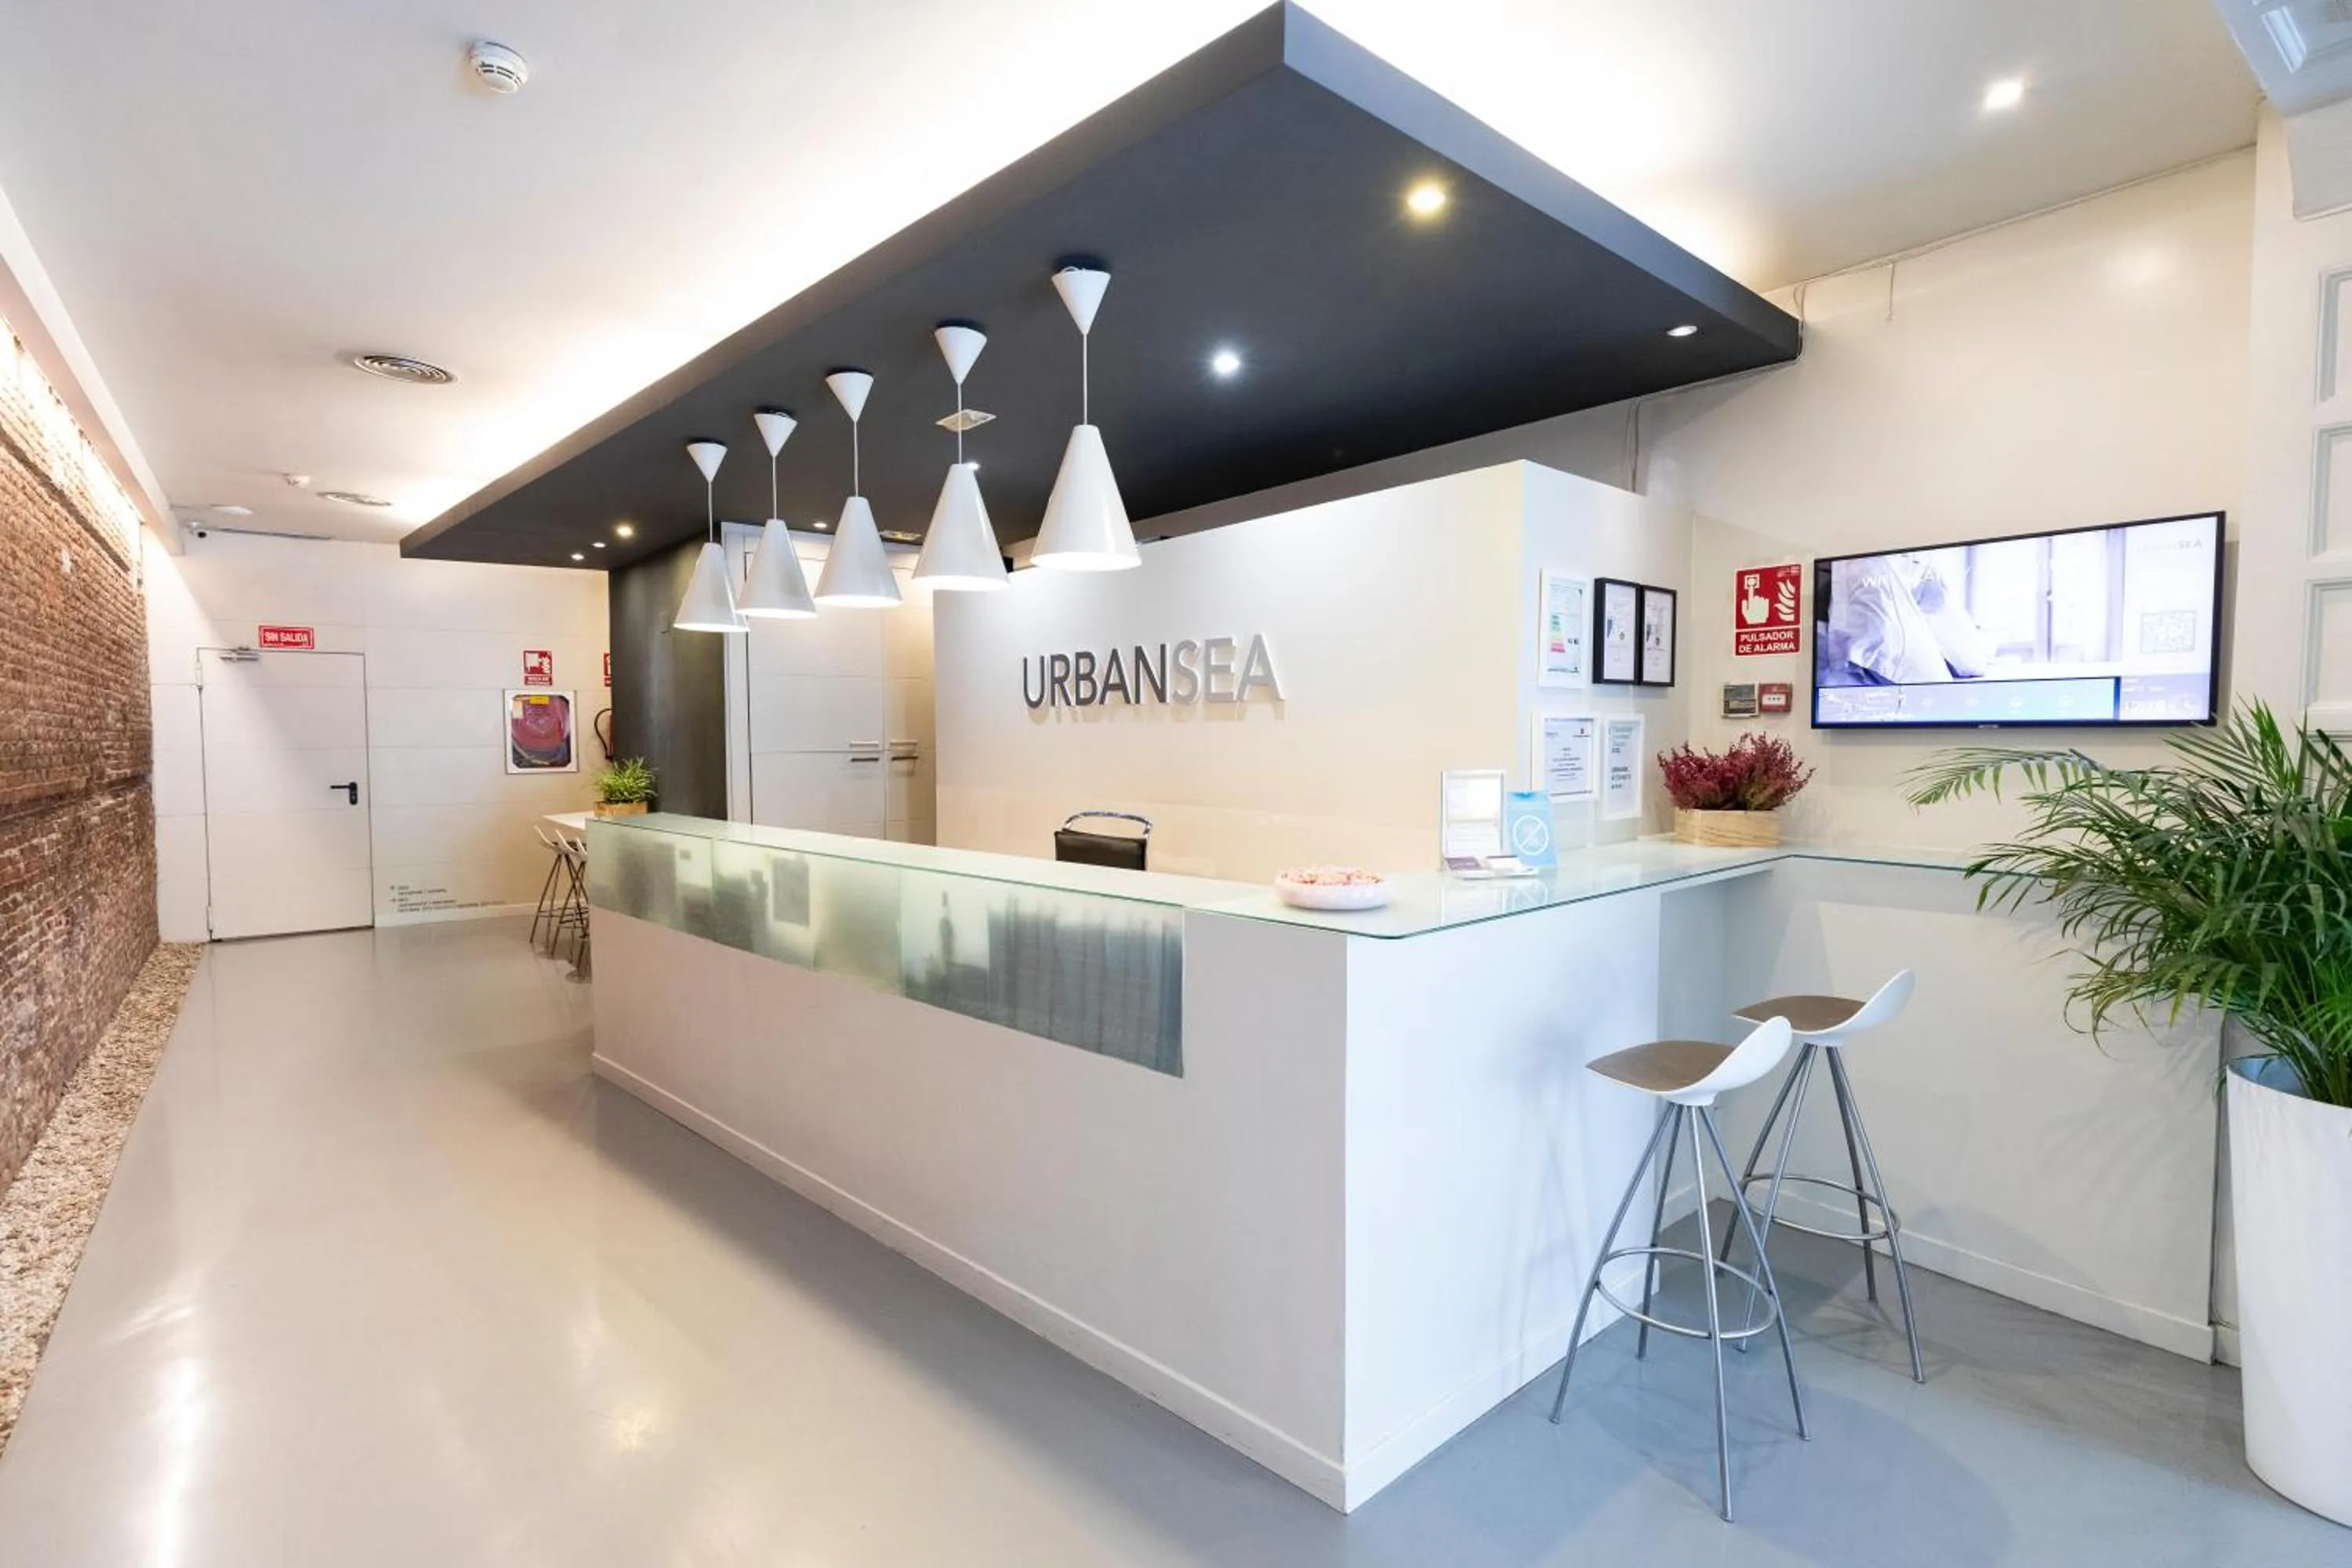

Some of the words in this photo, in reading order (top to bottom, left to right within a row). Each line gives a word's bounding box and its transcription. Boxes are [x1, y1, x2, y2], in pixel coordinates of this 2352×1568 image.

[264, 632, 278, 641] SIN
[280, 632, 308, 643] SALIDA
[1740, 630, 1794, 642] PULSADOR
[1738, 644, 1751, 653] DE
[1753, 641, 1795, 652] ALARMA
[1023, 633, 1284, 709] URBANSEA
